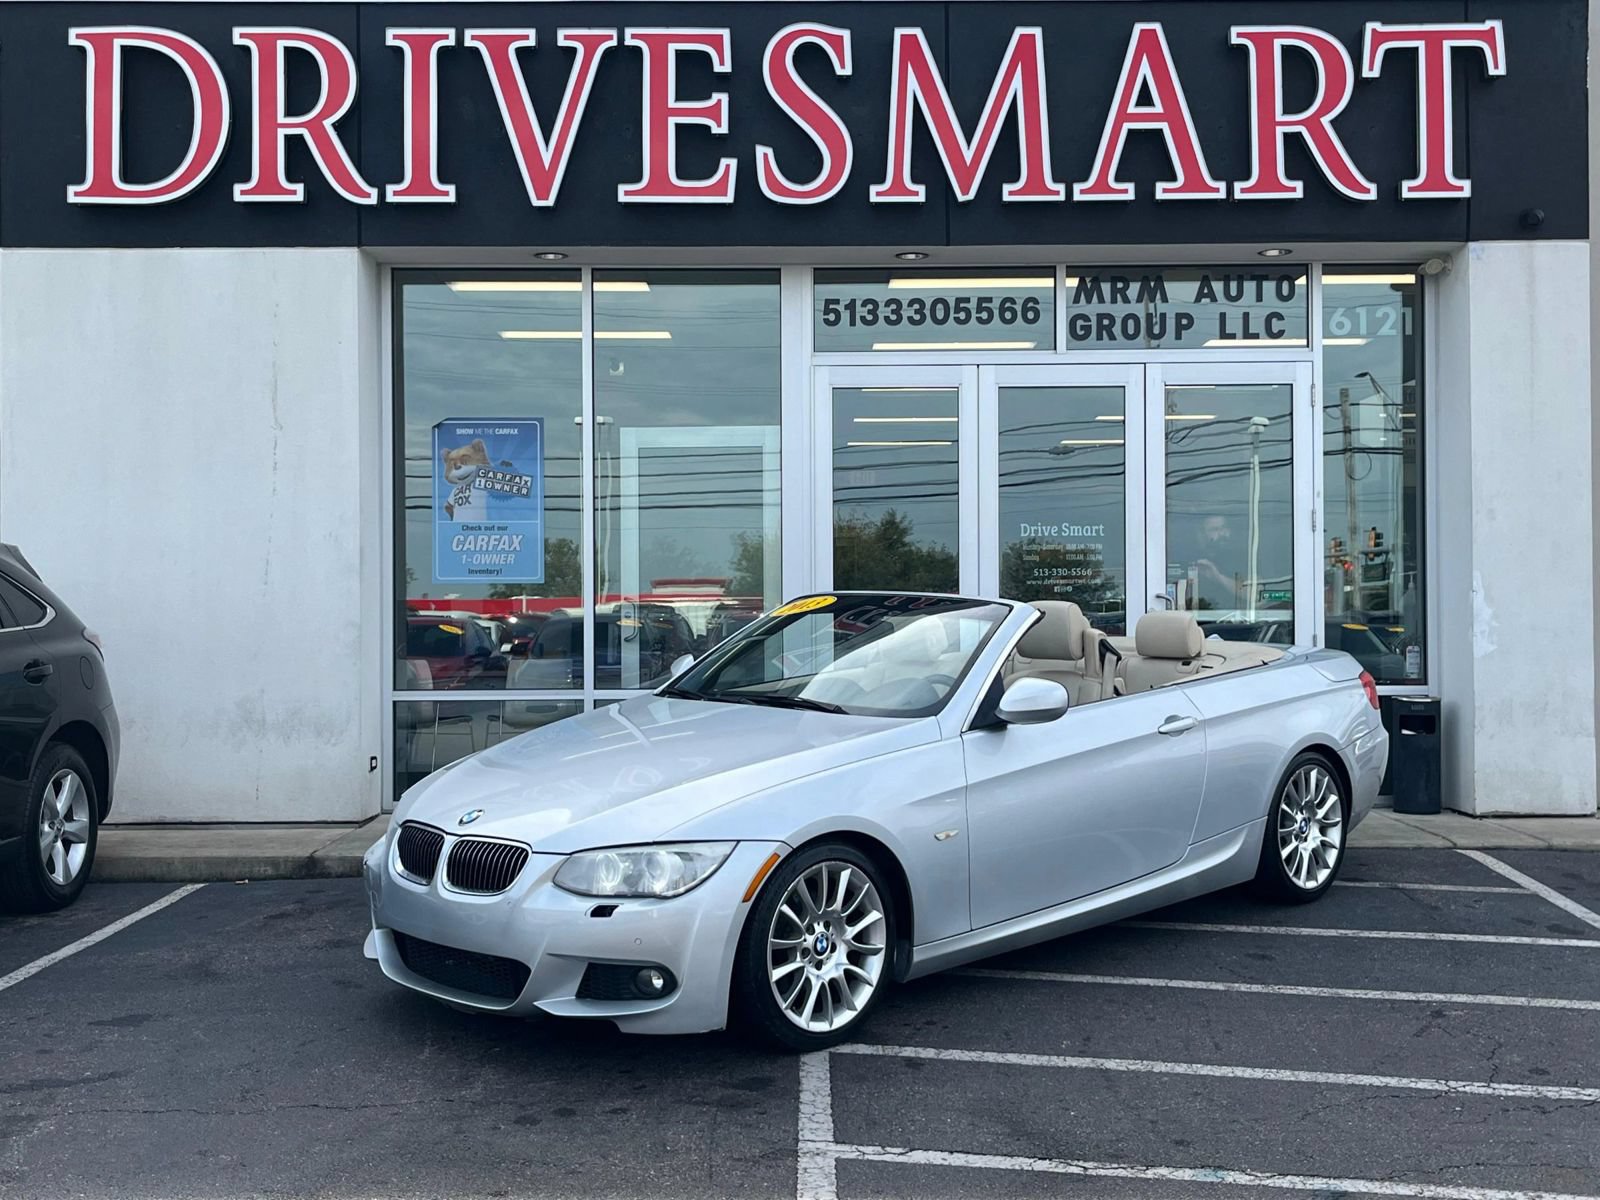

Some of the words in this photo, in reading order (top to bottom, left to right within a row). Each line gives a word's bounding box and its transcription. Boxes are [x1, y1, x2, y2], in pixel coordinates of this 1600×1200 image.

[66, 20, 1507, 208] DRIVESMART
[1072, 275, 1169, 304] MRM
[1193, 274, 1296, 303] AUTO
[822, 296, 1041, 327] 5133305566
[1068, 312, 1195, 341] GROUP
[1219, 311, 1286, 339] LLC
[1328, 306, 1413, 336] 6121
[479, 469, 530, 487] CARFAX
[454, 495, 472, 507] FOX
[1020, 522, 1059, 537] Drive
[1061, 522, 1105, 537] Smart
[452, 534, 523, 552] CARFAX
[461, 554, 516, 565] 1-OWNER
[467, 568, 503, 576] Inventory!
[1033, 567, 1093, 577] 513-330-5566
